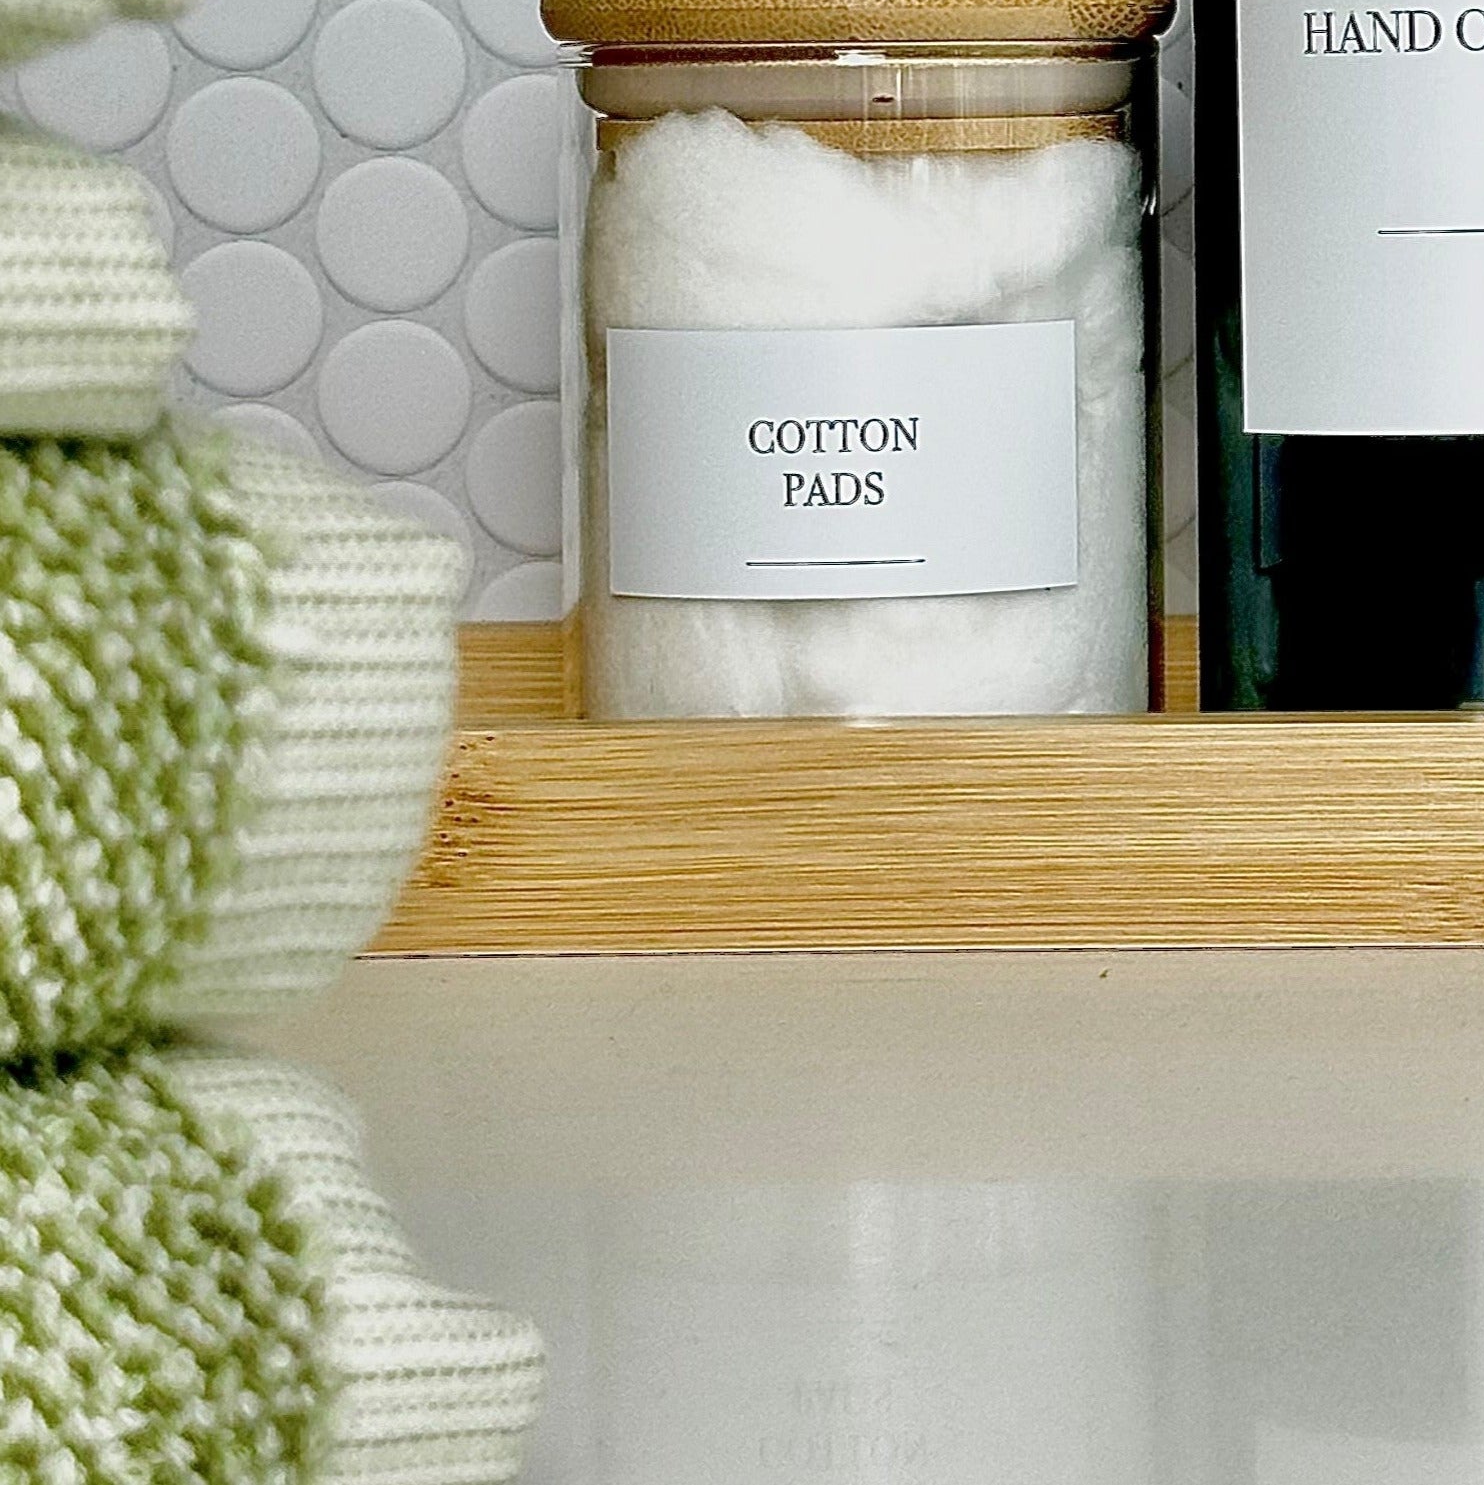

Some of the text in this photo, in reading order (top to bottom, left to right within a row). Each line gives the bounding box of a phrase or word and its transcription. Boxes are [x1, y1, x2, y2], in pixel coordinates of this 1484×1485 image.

[1303, 9, 1442, 55] HAND
[748, 417, 919, 455] COTTON
[782, 471, 885, 507] PADS
